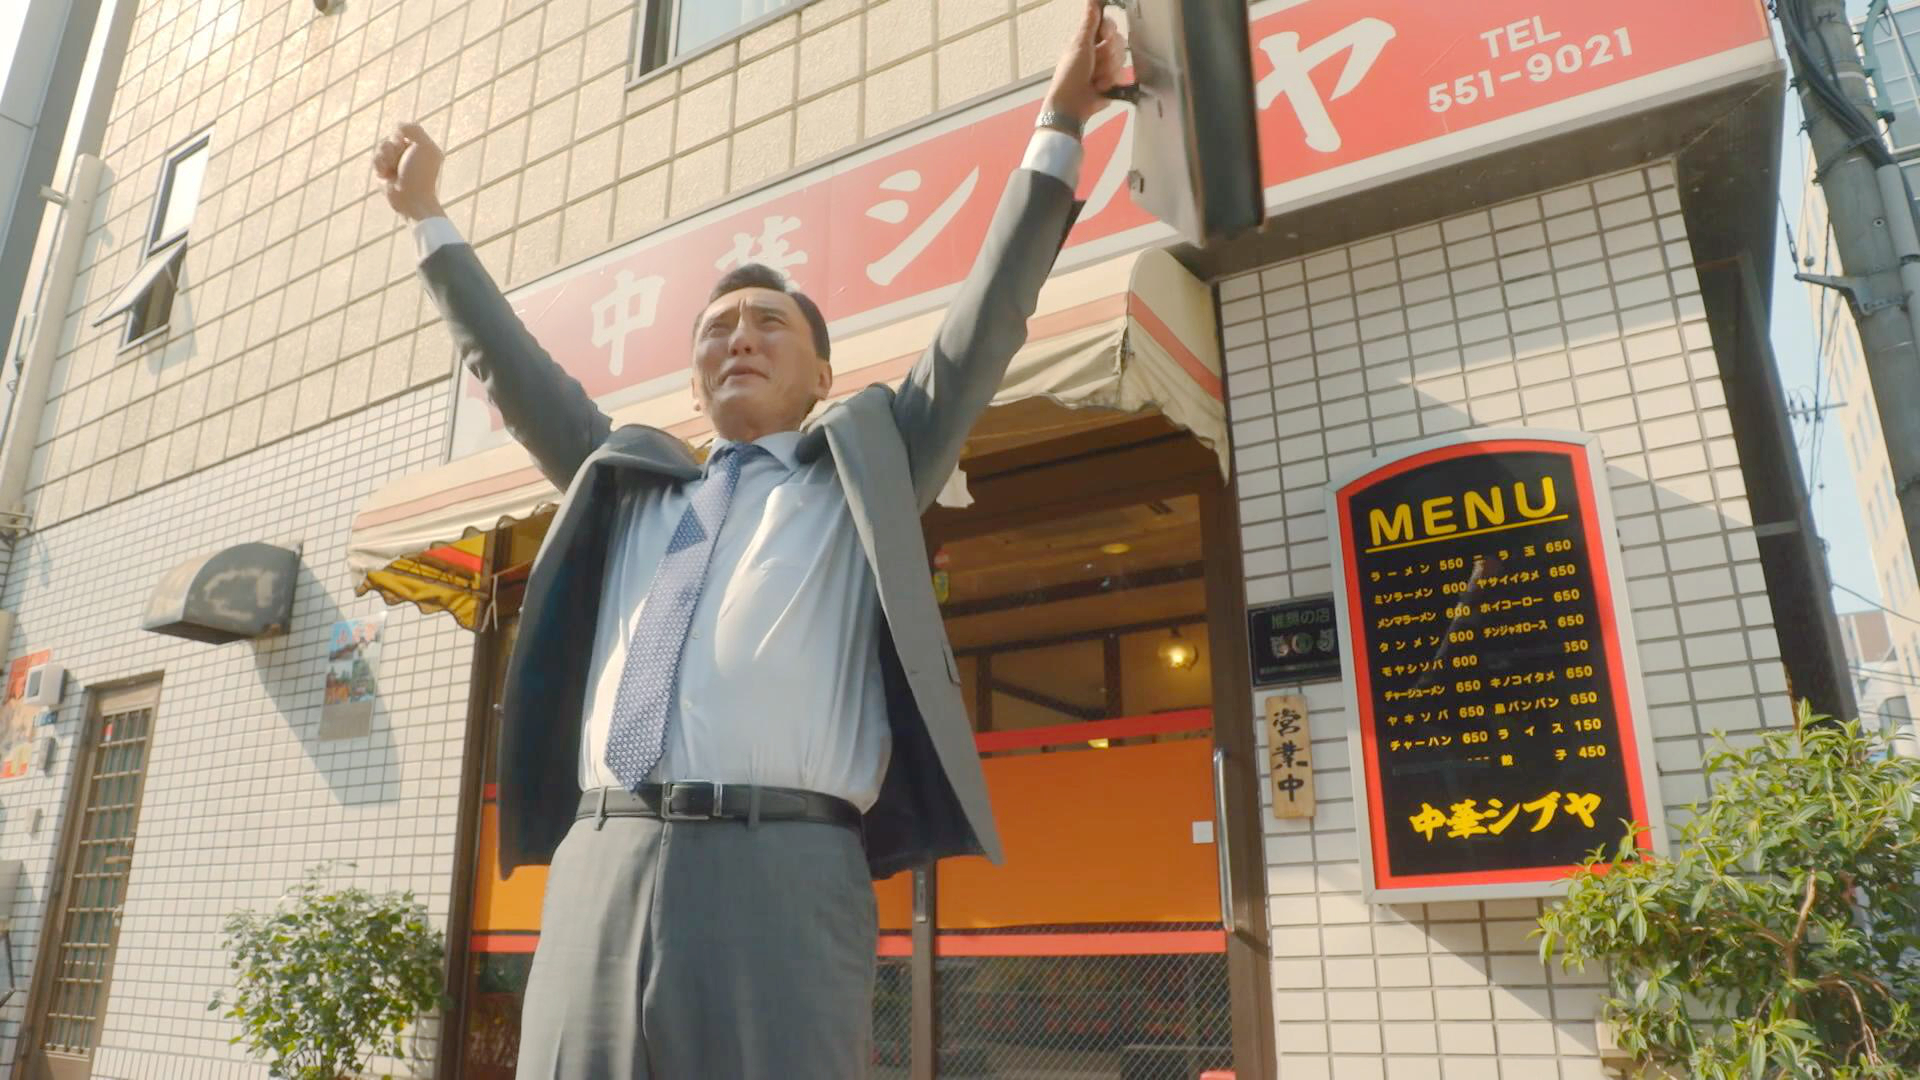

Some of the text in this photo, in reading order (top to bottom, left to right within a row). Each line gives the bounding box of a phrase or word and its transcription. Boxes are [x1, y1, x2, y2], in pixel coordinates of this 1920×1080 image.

[1480, 15, 1561, 59] TEL
[1428, 27, 1633, 113] 551-9021
[1368, 476, 1557, 546] MENU
[1545, 539, 1571, 553] 650
[1370, 557, 1463, 582] ラーメン 550
[1549, 563, 1576, 578] 650
[1442, 581, 1467, 595] 600
[1445, 605, 1471, 619] 600
[1480, 588, 1580, 614] ホイコーロー 650
[1557, 613, 1584, 628] 650
[1379, 630, 1474, 653] タンメン 600
[1381, 655, 1478, 677] モヤシソバ 600
[1490, 665, 1593, 688] キノコイタメ 650
[1456, 680, 1481, 693] 650
[1570, 691, 1597, 705] 650
[1387, 705, 1485, 726] ヤキソバ 650
[1497, 718, 1602, 740] ライス 150
[1390, 731, 1488, 752] チャーハン 650
[1578, 745, 1606, 759] 450
[1272, 708, 1308, 803] 営業中
[1408, 791, 1602, 843] 中華シブヤ
